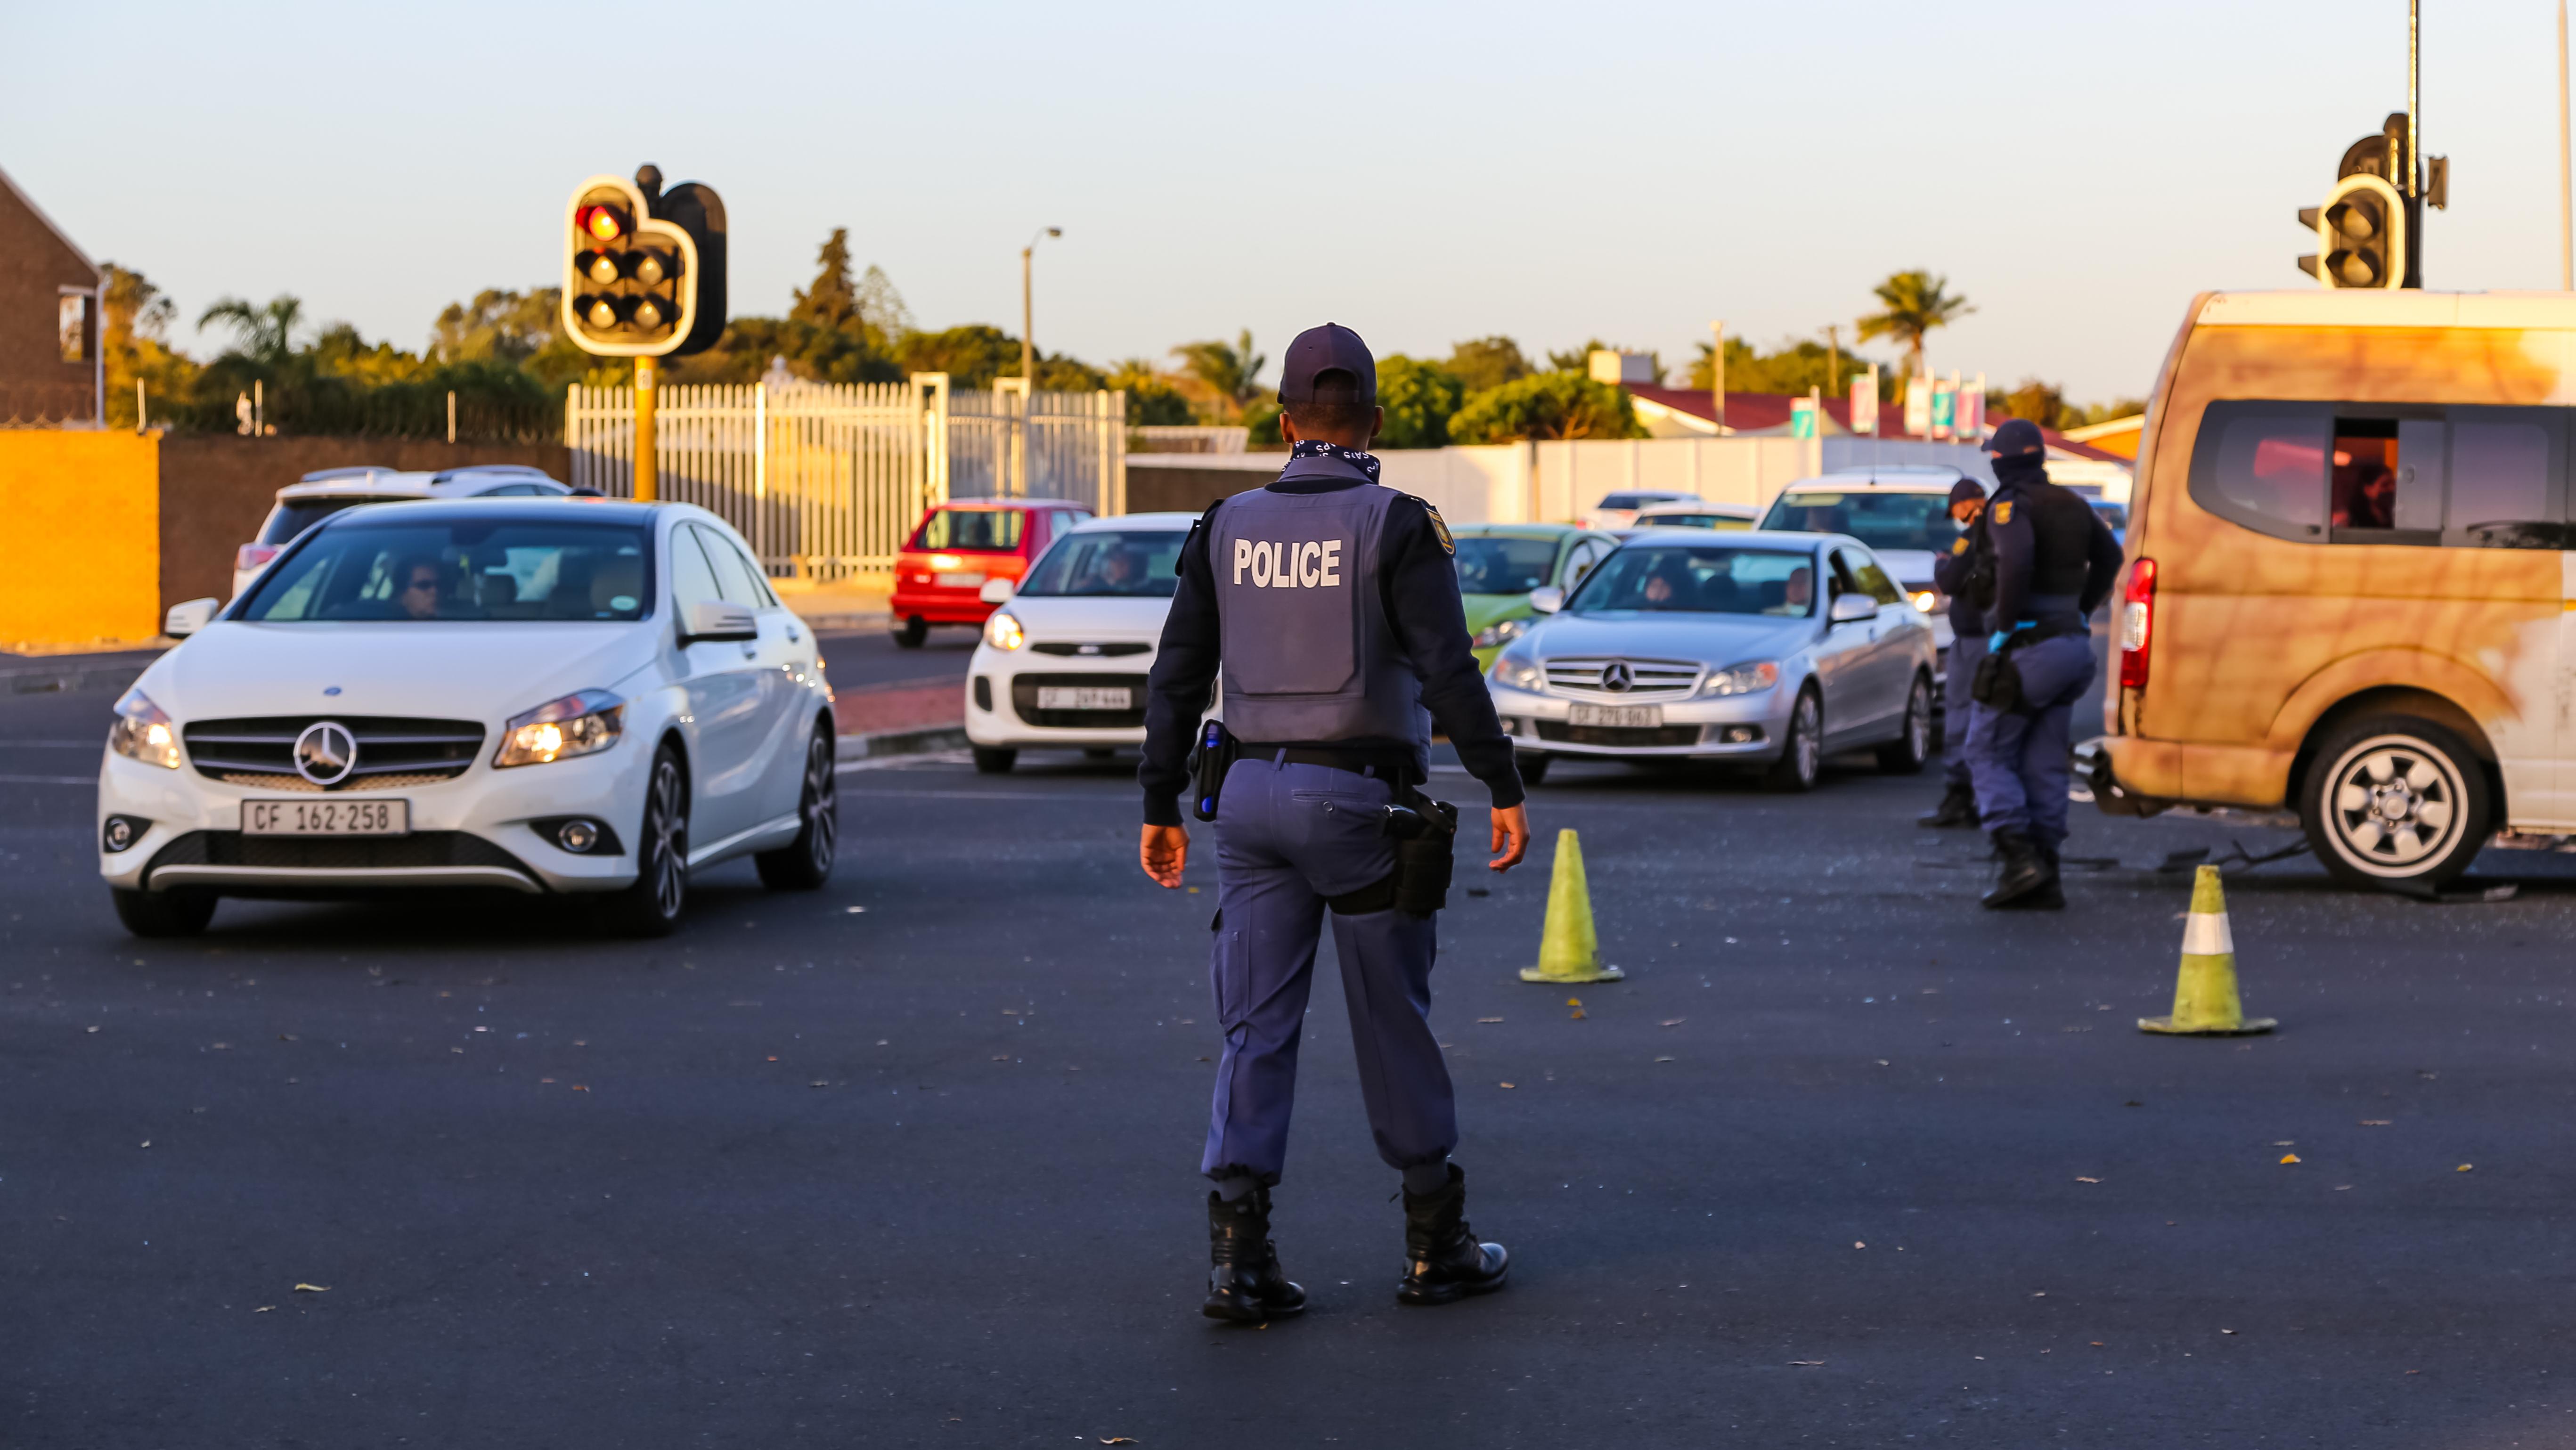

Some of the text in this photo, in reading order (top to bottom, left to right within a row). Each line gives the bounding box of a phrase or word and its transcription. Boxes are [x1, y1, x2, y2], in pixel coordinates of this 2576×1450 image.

[1234, 538, 1341, 588] POLICE
[255, 804, 389, 830] CF 162-258
